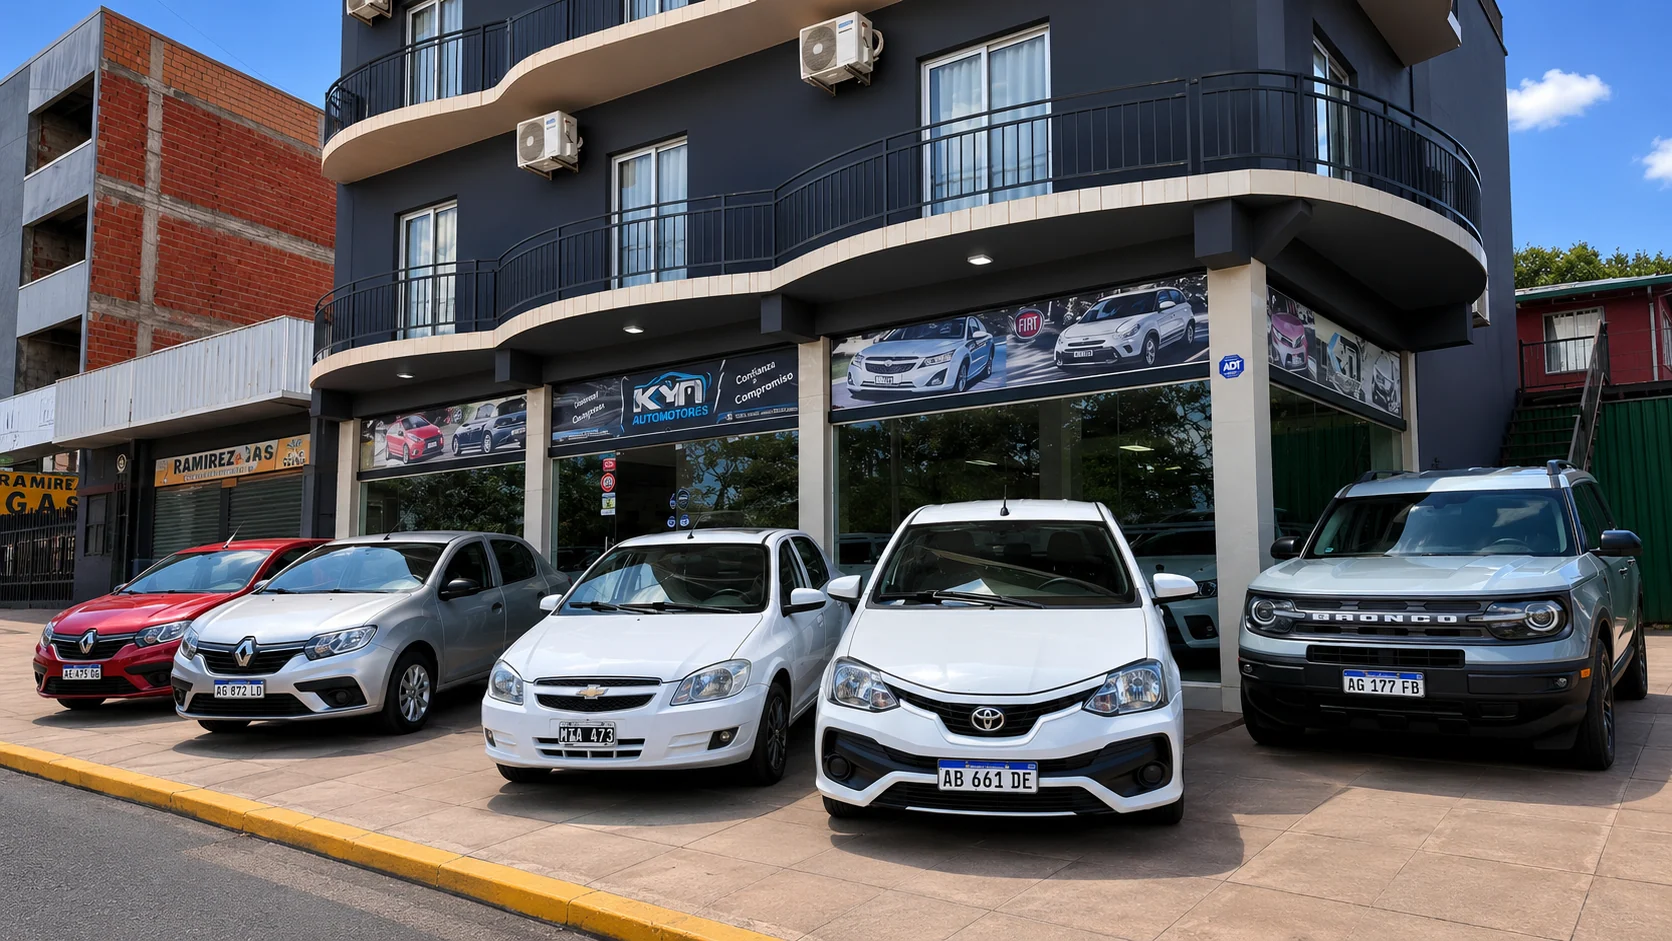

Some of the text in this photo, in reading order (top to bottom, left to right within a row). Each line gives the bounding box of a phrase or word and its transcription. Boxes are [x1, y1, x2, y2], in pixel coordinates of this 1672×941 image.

[1018, 315, 1038, 333] FIAT
[735, 361, 776, 385] Confianza
[1223, 360, 1242, 372] ADT
[734, 372, 794, 405] Compromiso
[632, 405, 709, 425] AUTOMOTORES
[174, 450, 236, 475] RAMIREZ
[216, 685, 262, 696] AG 872 LD
[1347, 677, 1420, 694] AG 177 FB
[590, 728, 613, 742] 473
[943, 769, 1033, 789] AB 661 DE
